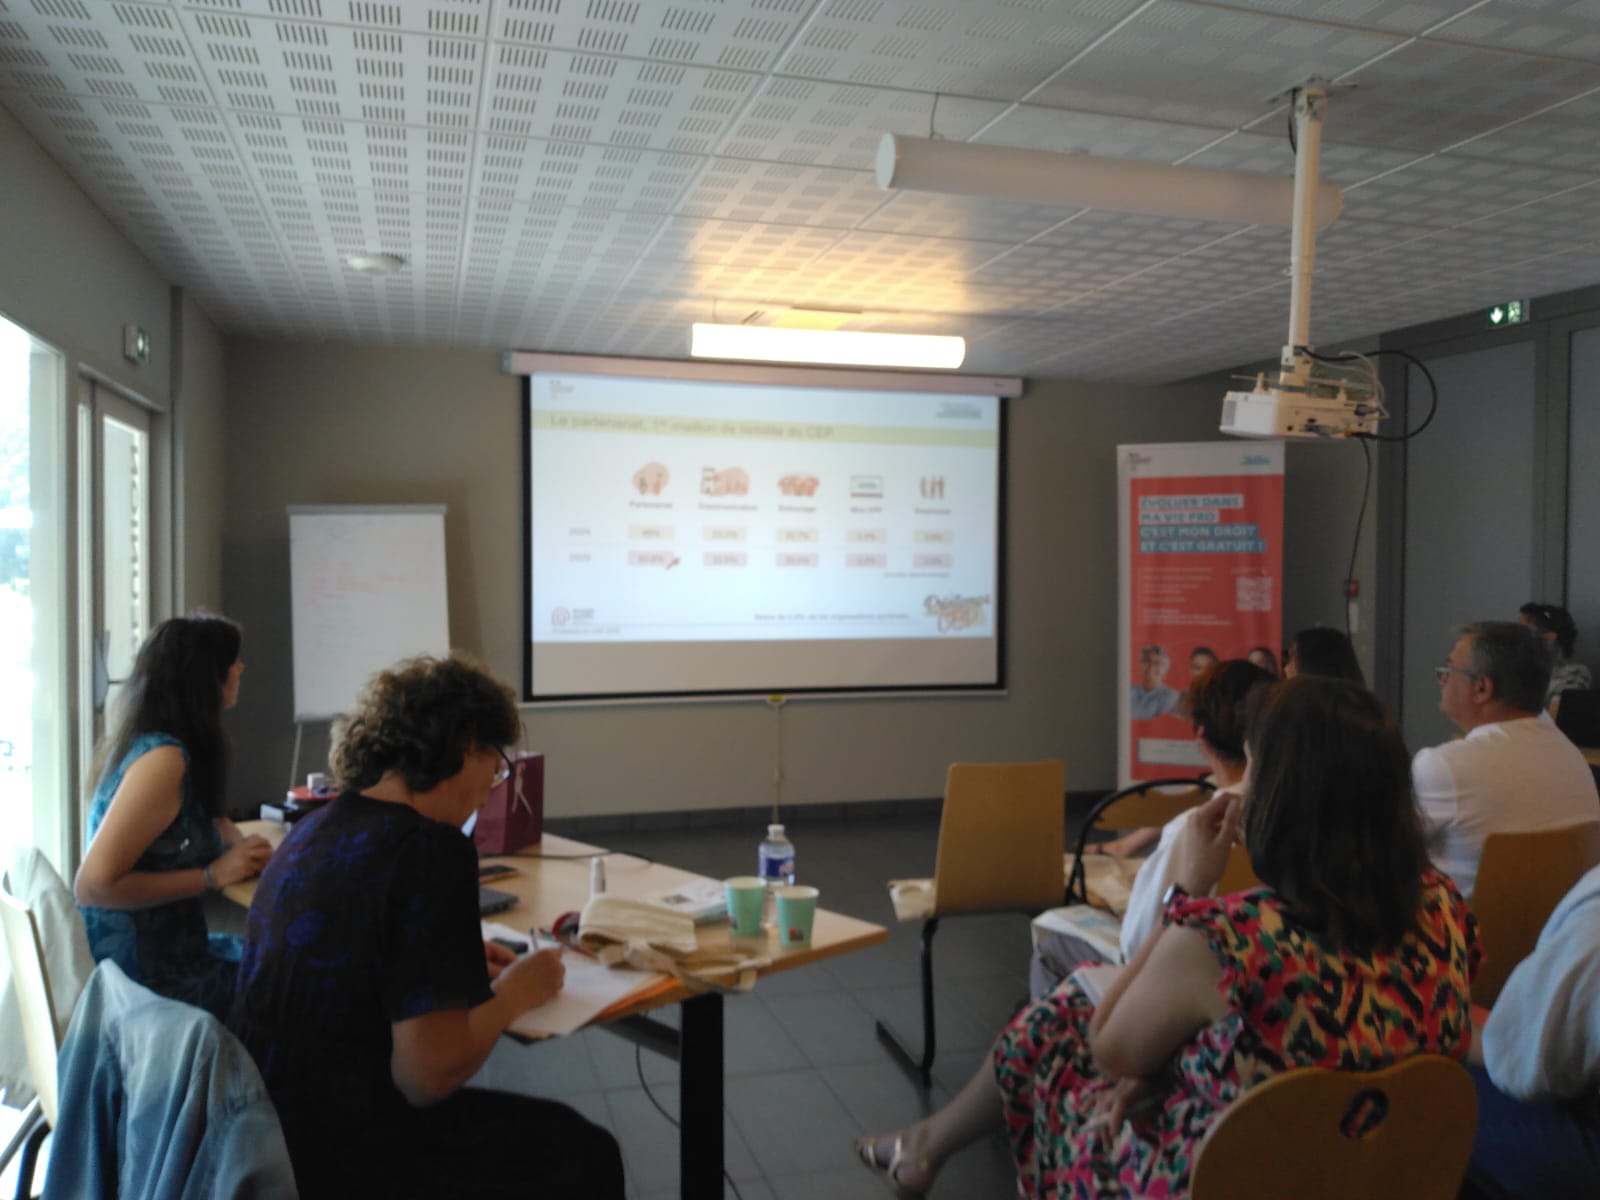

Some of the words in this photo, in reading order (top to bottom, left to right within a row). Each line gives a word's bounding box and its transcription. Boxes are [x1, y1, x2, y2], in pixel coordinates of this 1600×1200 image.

[1202, 495, 1240, 507] DANS
[1141, 511, 1160, 522] MA
[1164, 511, 1185, 522] VIE
[1189, 511, 1216, 522] PRO
[1140, 526, 1176, 537] C'EST
[1178, 526, 1210, 537] MON
[1214, 525, 1256, 536] DROIT
[1140, 540, 1156, 552] ET
[1158, 540, 1194, 552] C'EST
[1196, 540, 1255, 552] GRATUIT
